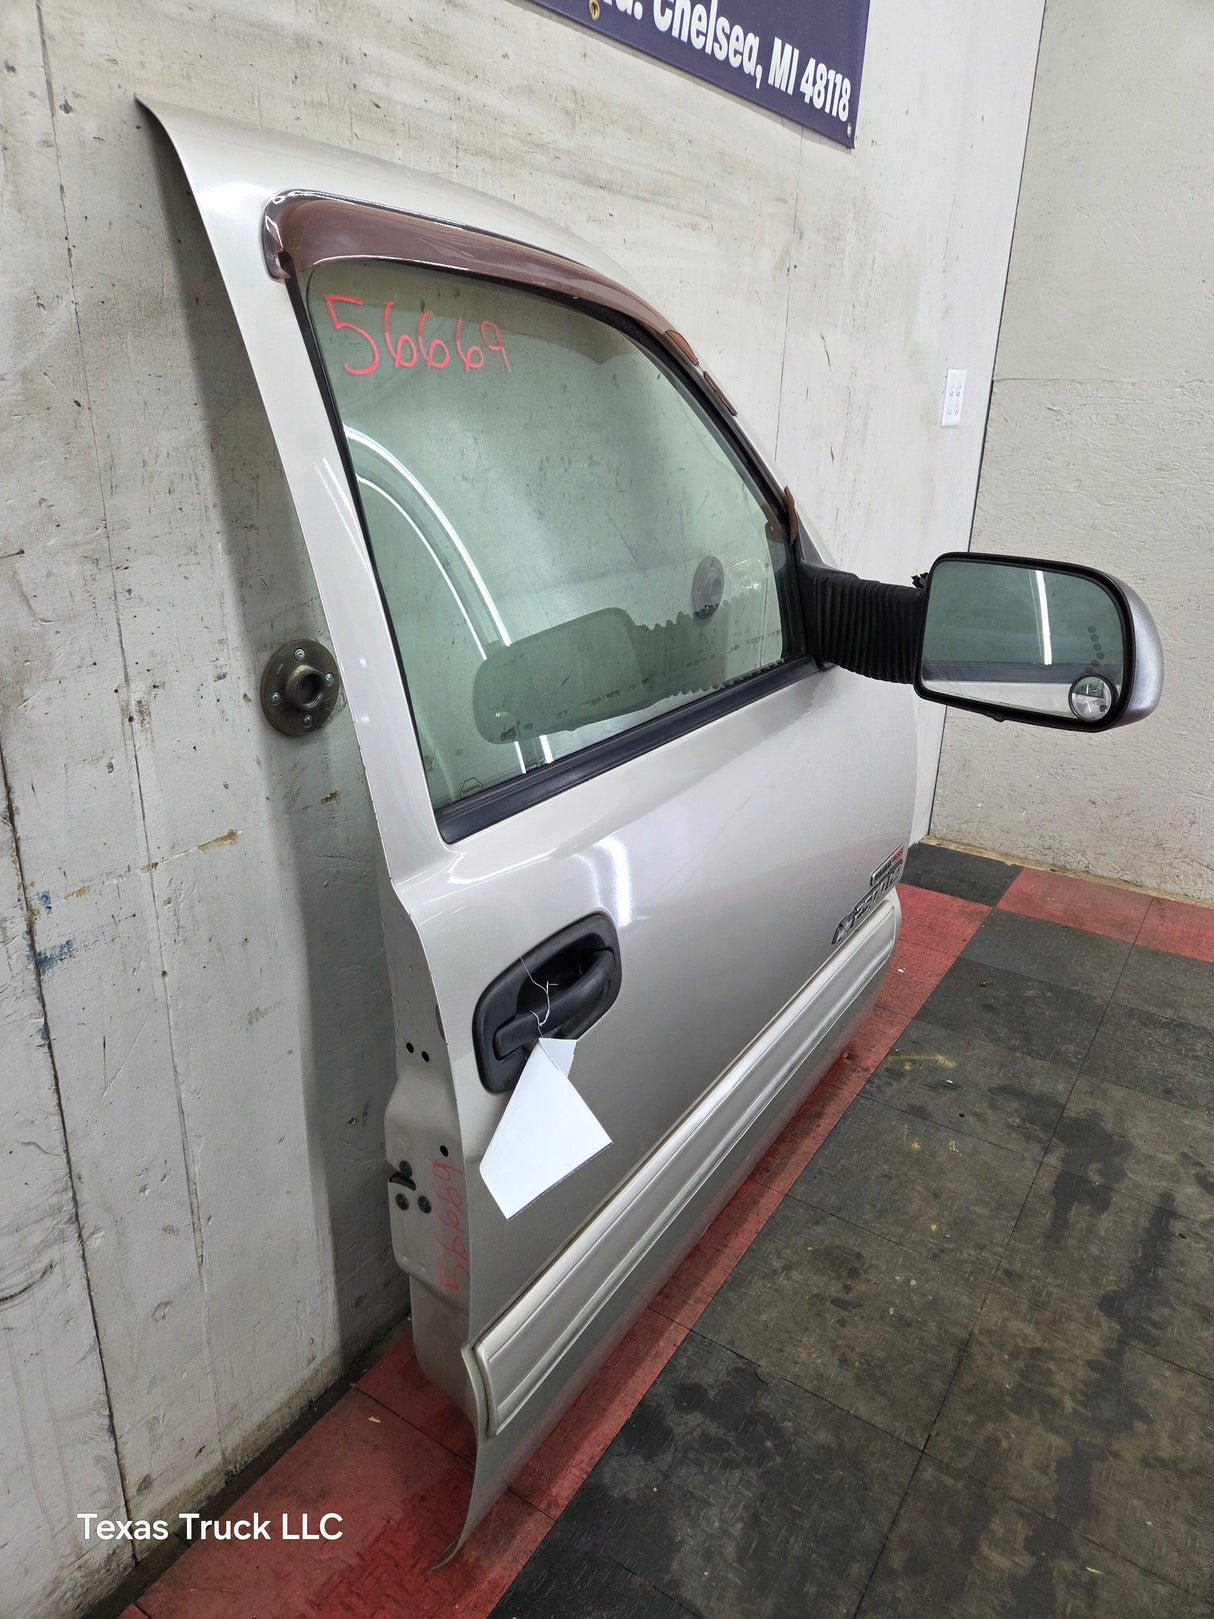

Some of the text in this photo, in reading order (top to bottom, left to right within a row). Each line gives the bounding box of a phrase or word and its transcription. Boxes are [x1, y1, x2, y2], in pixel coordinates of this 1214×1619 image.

[768, 36, 799, 96] MI
[800, 57, 851, 122] 48118
[325, 294, 512, 376] 56669
[432, 1160, 470, 1291] 56669
